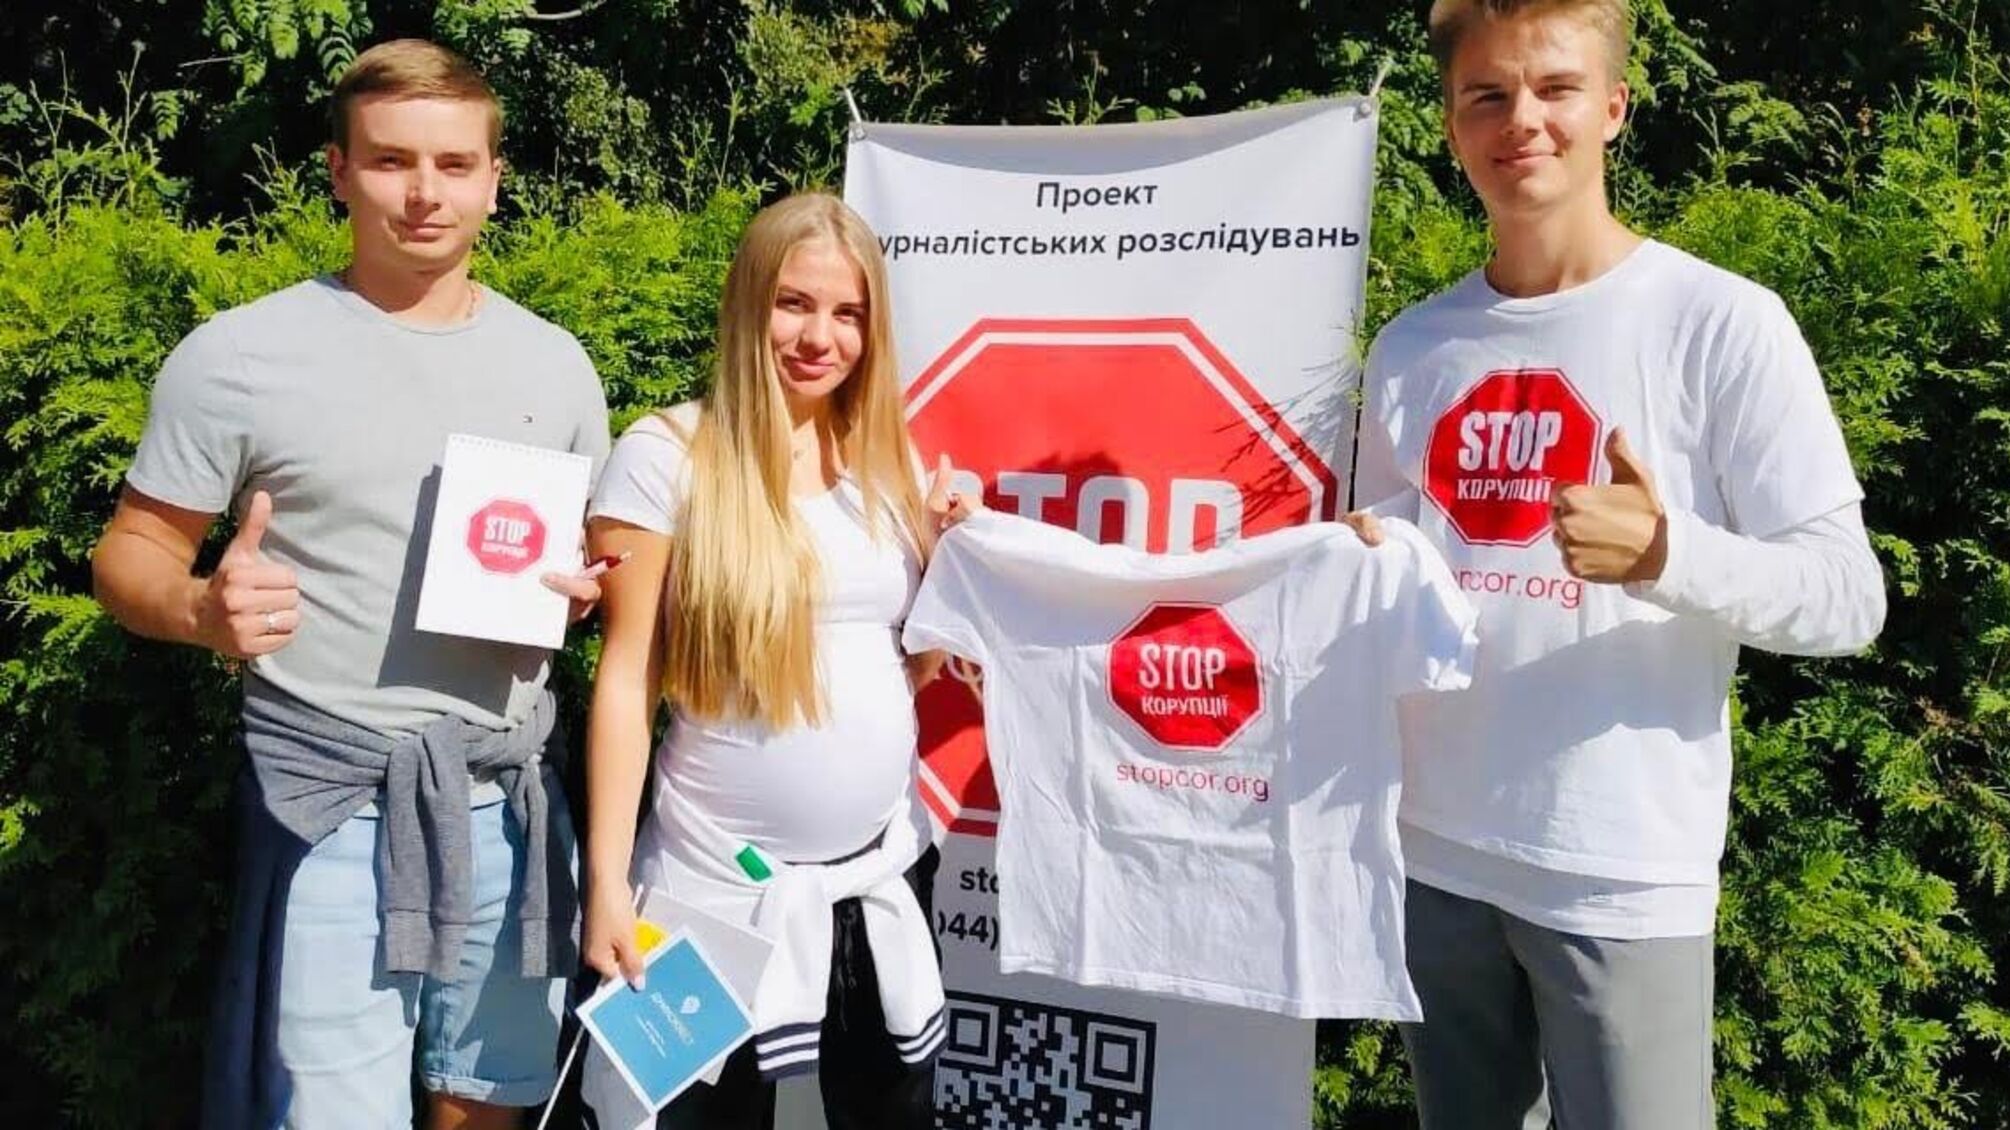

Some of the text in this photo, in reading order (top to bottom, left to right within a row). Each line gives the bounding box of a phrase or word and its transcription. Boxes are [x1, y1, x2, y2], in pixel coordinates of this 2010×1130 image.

[1037, 181, 1158, 214] Проект
[877, 222, 1360, 260] урналістських розслідувань
[1458, 411, 1562, 471] STOP
[484, 516, 531, 546] STOP
[1139, 643, 1226, 690] STOP
[1142, 695, 1228, 718] КОРУПЦІЇ
[1116, 762, 1270, 802] stopcor.org
